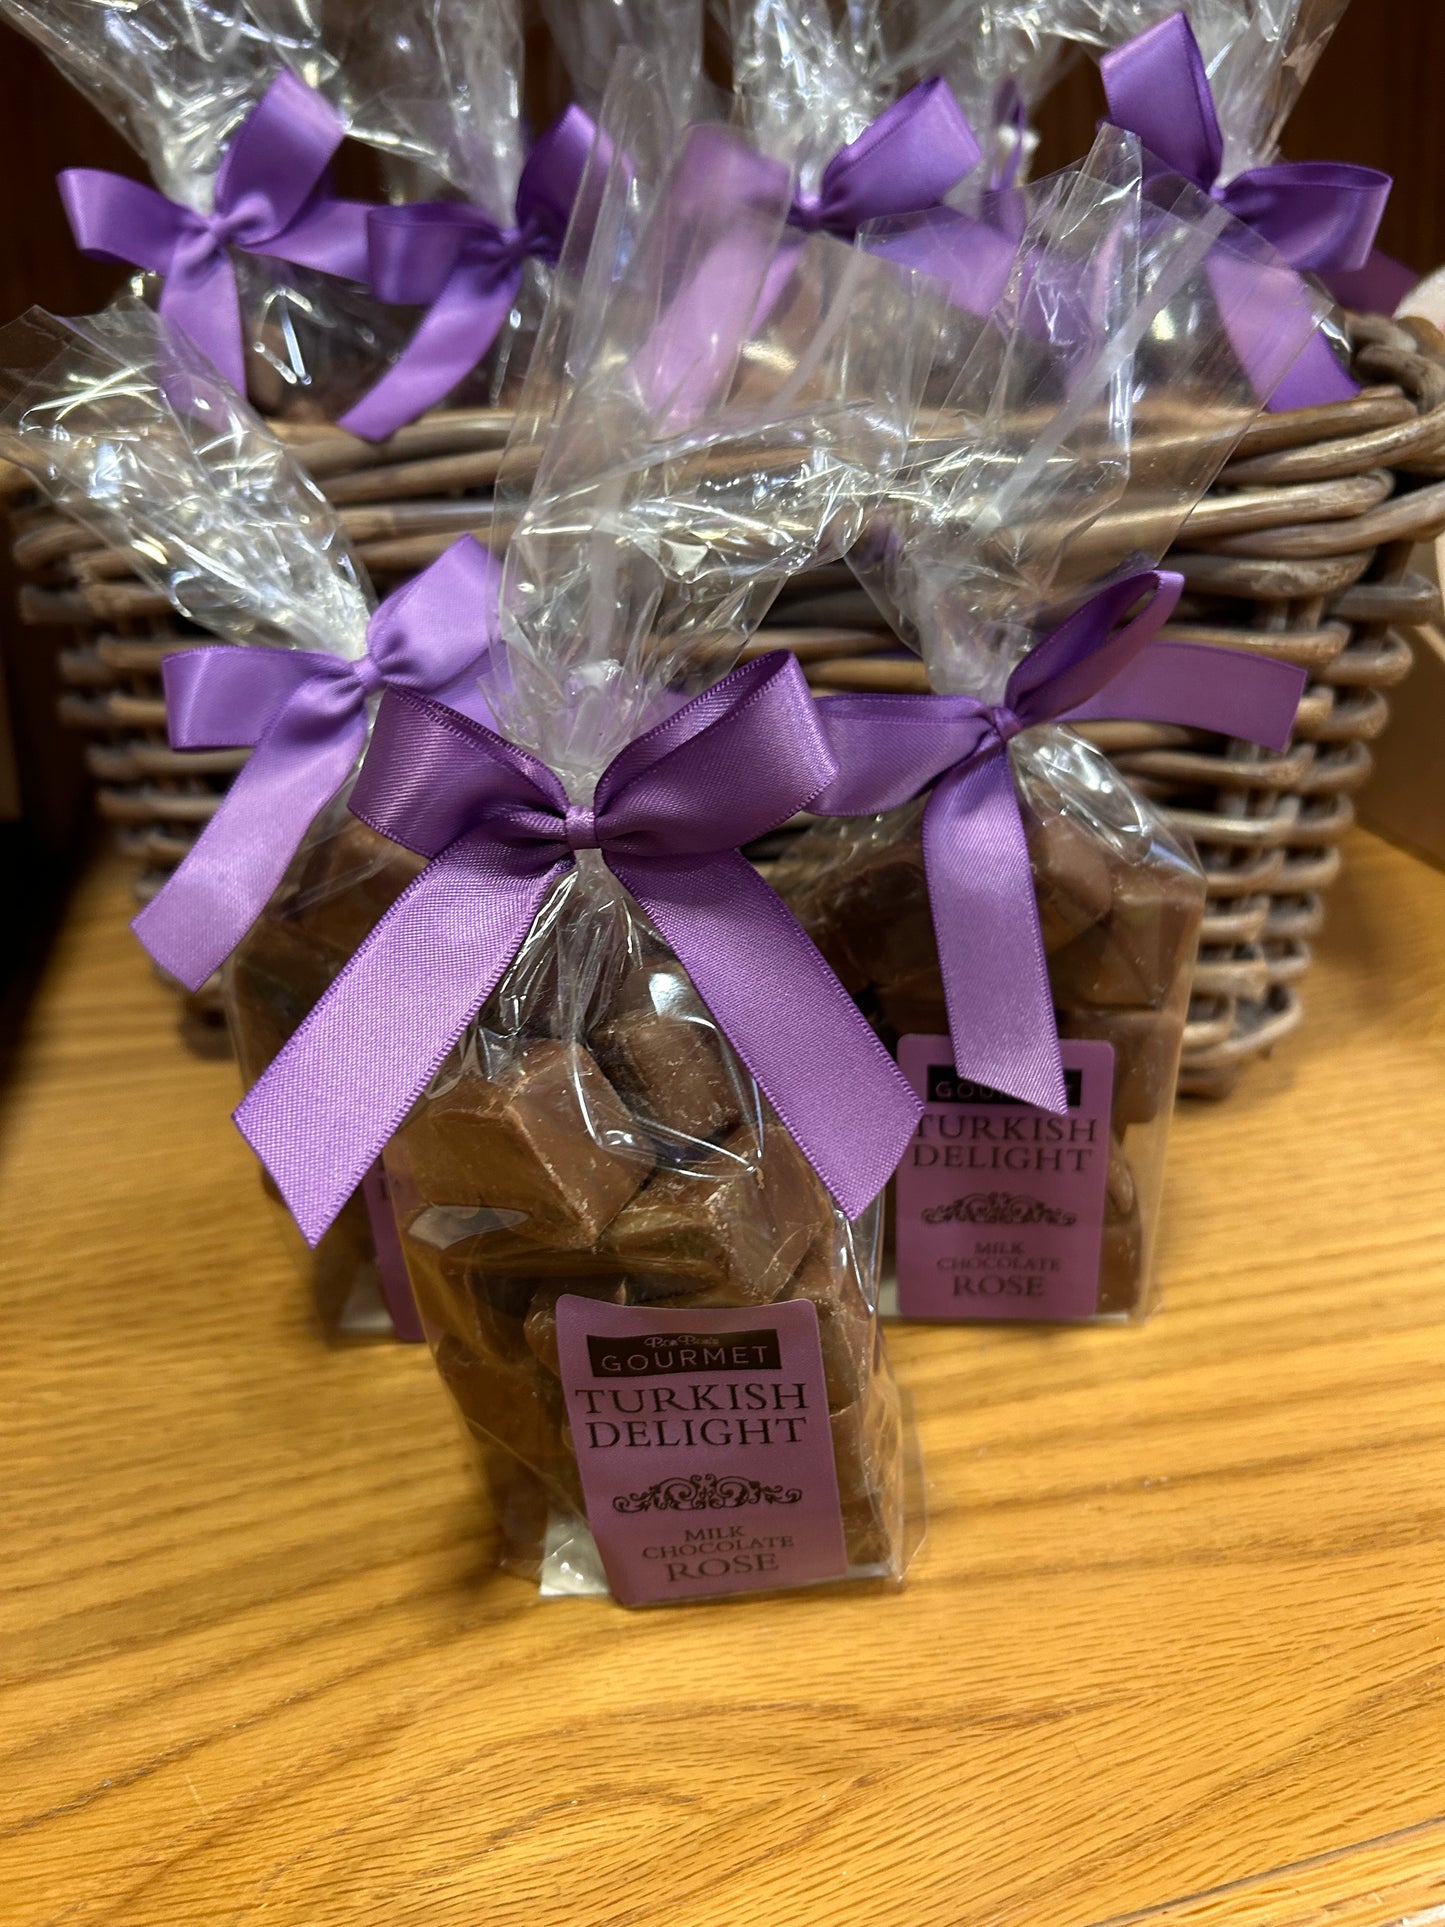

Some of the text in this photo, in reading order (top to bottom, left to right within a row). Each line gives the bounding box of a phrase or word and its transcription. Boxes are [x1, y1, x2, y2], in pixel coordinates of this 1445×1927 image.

[915, 1114, 1097, 1143] TURKISH
[913, 1144, 1094, 1171] DELIGHT
[974, 1241, 1025, 1255] MILK
[936, 1257, 1061, 1272] CHOCOLATE
[953, 1275, 1046, 1297] ROSE
[601, 1345, 769, 1373] GOURMET
[575, 1382, 811, 1414] TURKISH
[585, 1416, 808, 1449] DELIGHT
[684, 1525, 745, 1542] MILK
[642, 1535, 795, 1560] CHOCOLATE
[667, 1553, 780, 1583] ROSE
